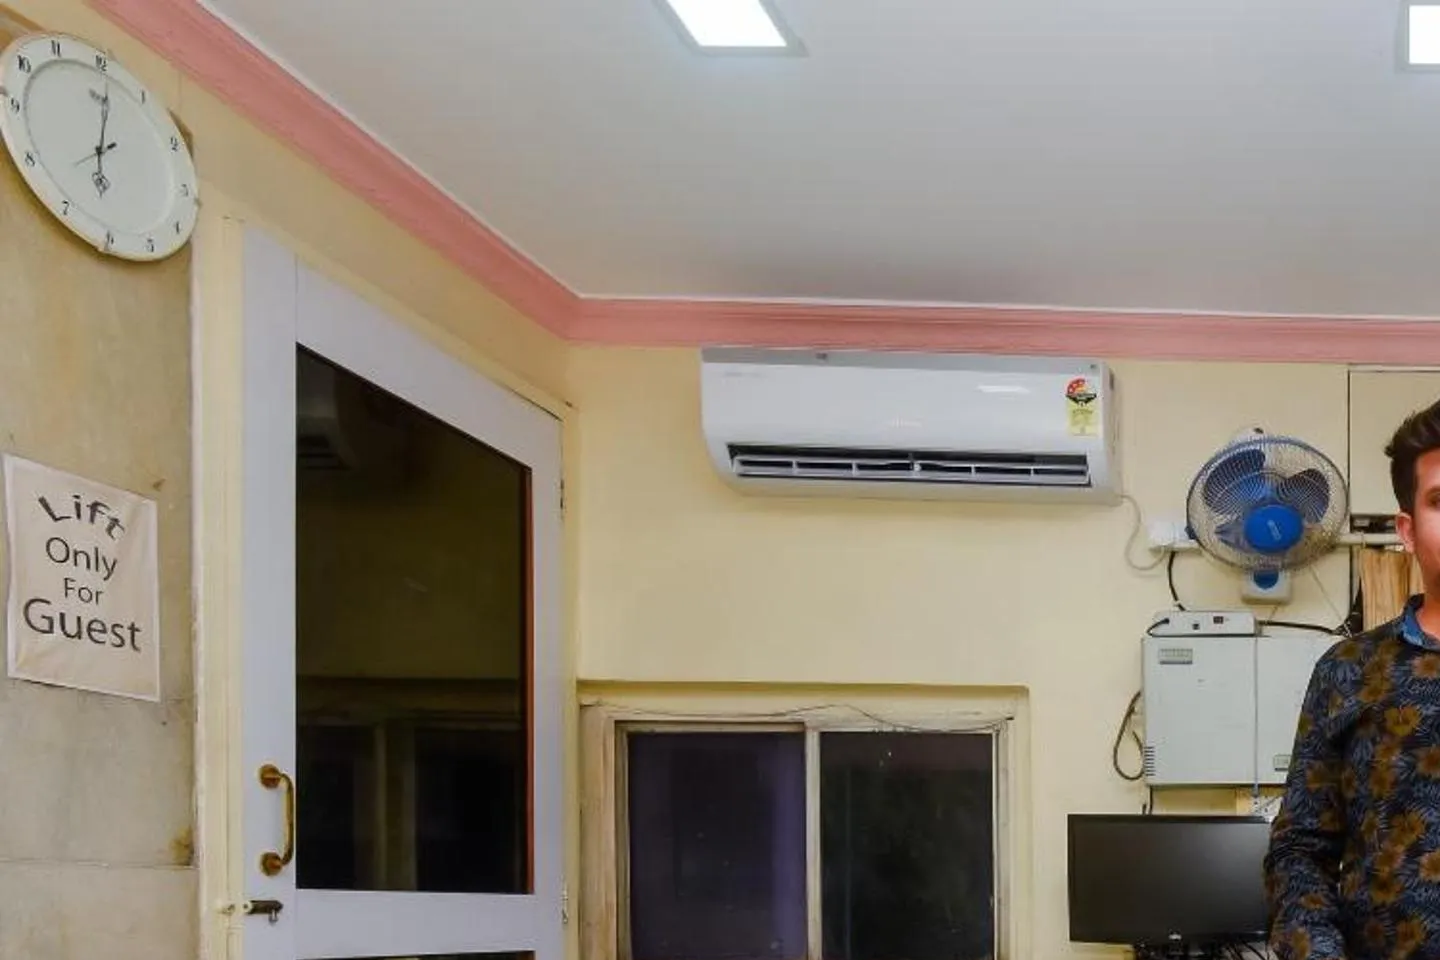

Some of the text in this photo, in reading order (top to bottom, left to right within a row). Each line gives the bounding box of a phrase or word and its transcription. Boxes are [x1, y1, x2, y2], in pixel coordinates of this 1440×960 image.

[38, 495, 125, 540] Lift
[46, 537, 117, 580] Only
[63, 577, 103, 604] For
[23, 598, 141, 652] Guest
